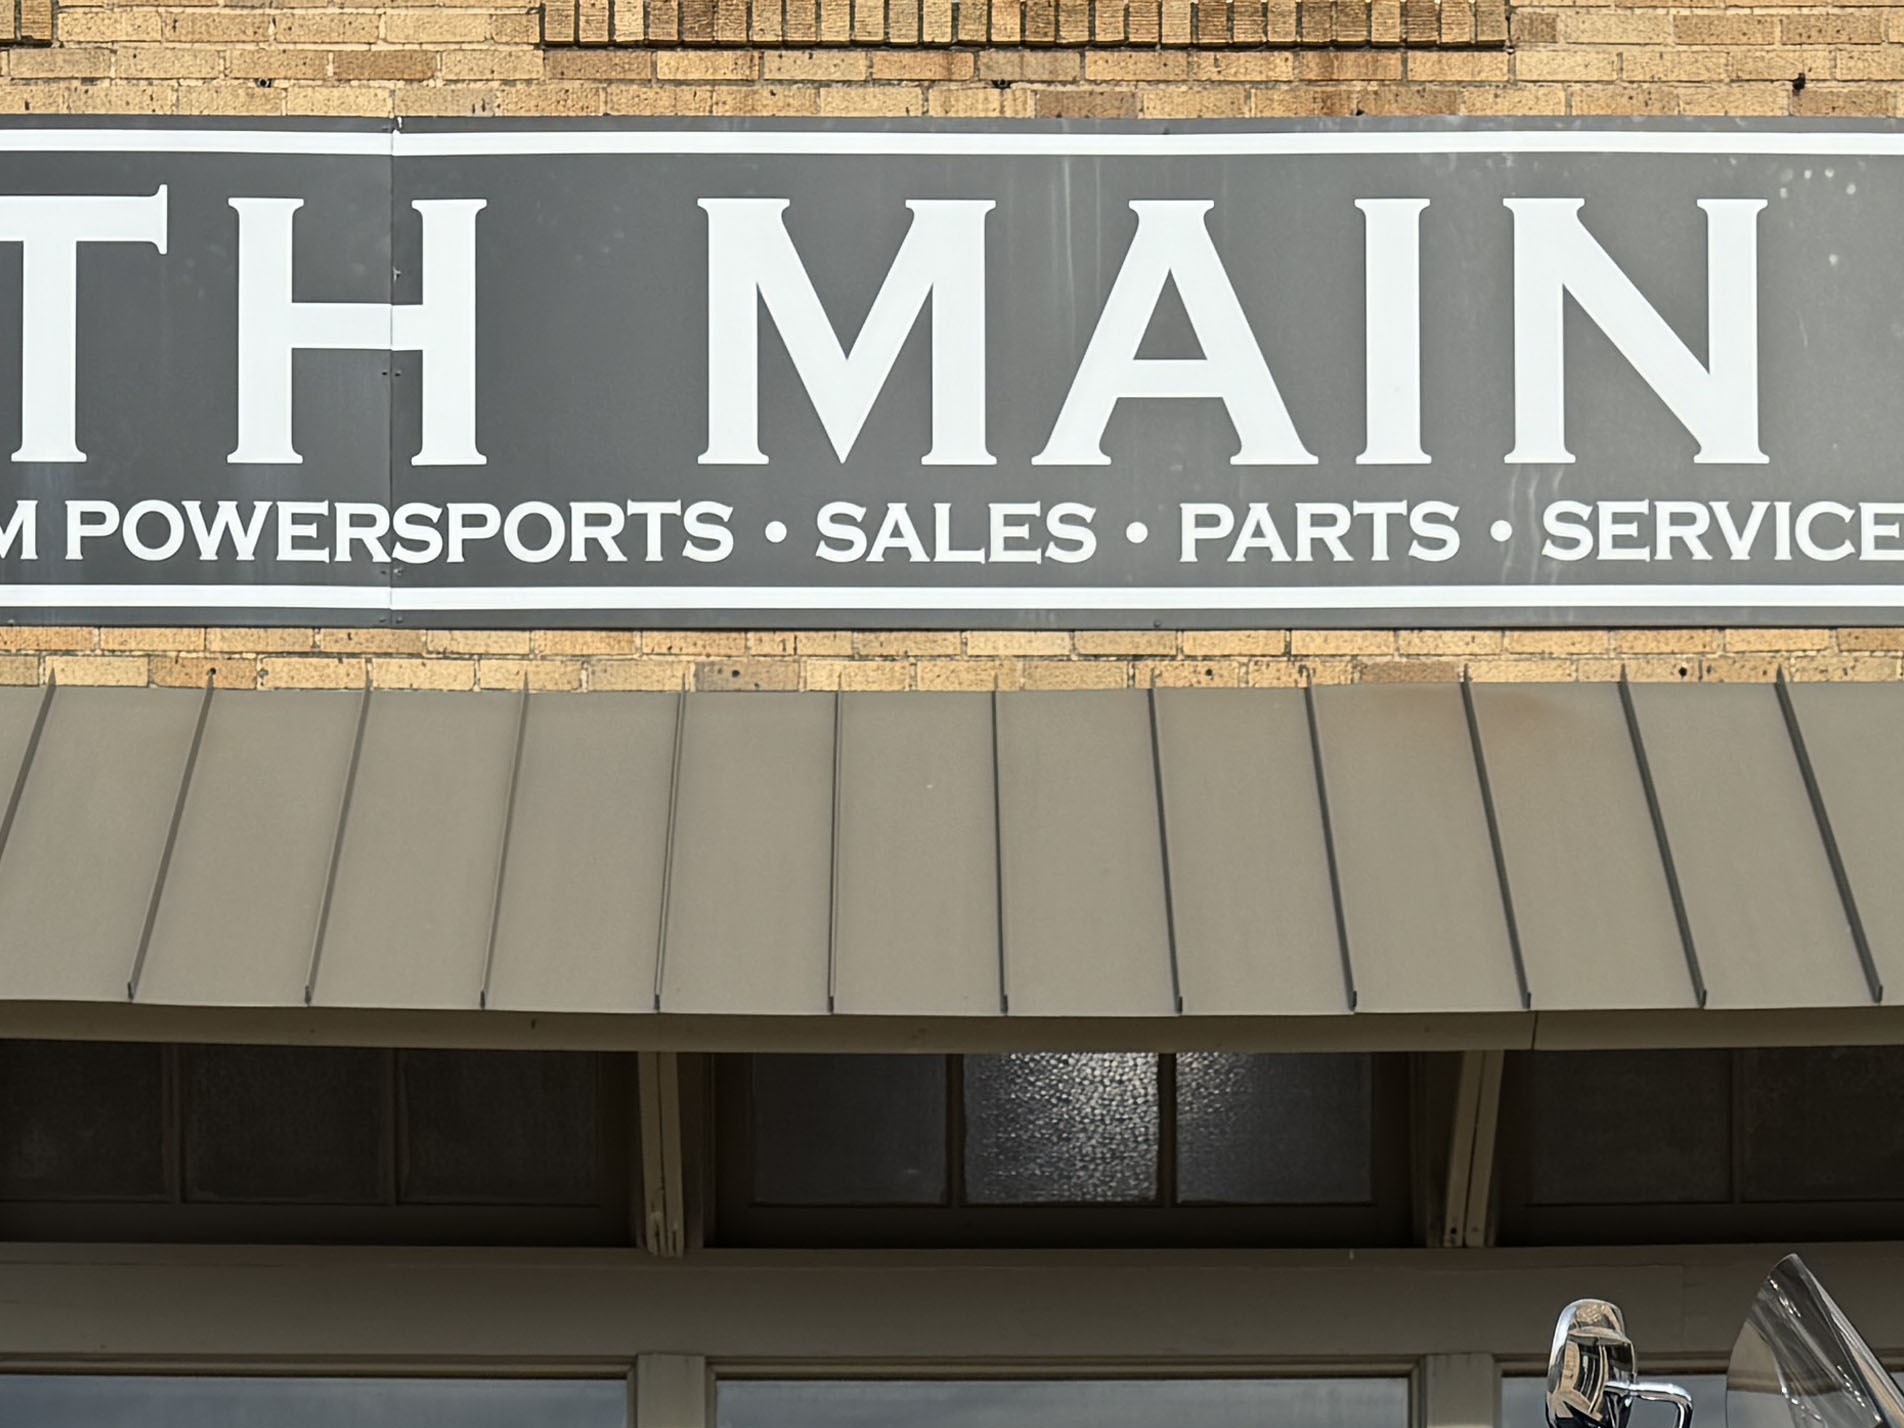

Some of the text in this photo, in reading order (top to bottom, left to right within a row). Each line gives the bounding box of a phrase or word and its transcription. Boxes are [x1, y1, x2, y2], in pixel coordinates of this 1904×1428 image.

[698, 198, 1770, 465] MAIN
[65, 500, 733, 563] POWERSPORTS
[816, 501, 1097, 564] SALES
[1180, 500, 1460, 562] PARTS
